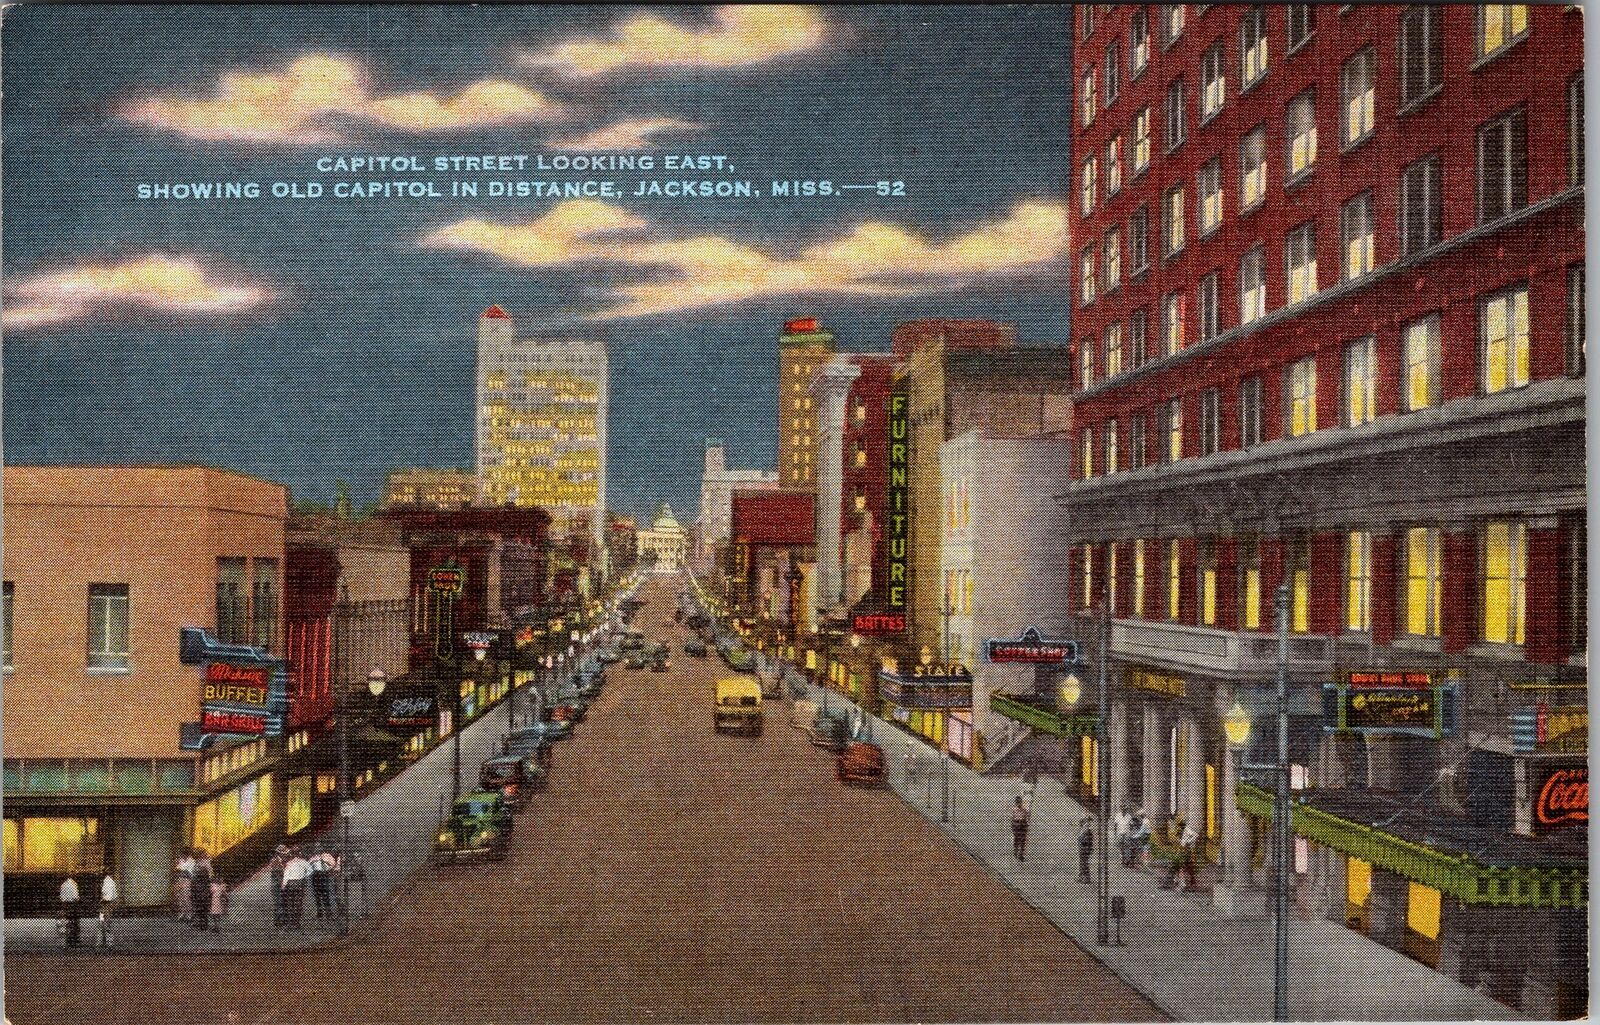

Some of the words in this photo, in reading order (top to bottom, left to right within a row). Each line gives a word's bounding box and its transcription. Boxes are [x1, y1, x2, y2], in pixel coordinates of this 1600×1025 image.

[891, 396, 906, 607] FURNITURE
[914, 664, 965, 677] STATE
[205, 684, 268, 703] BUFFET
